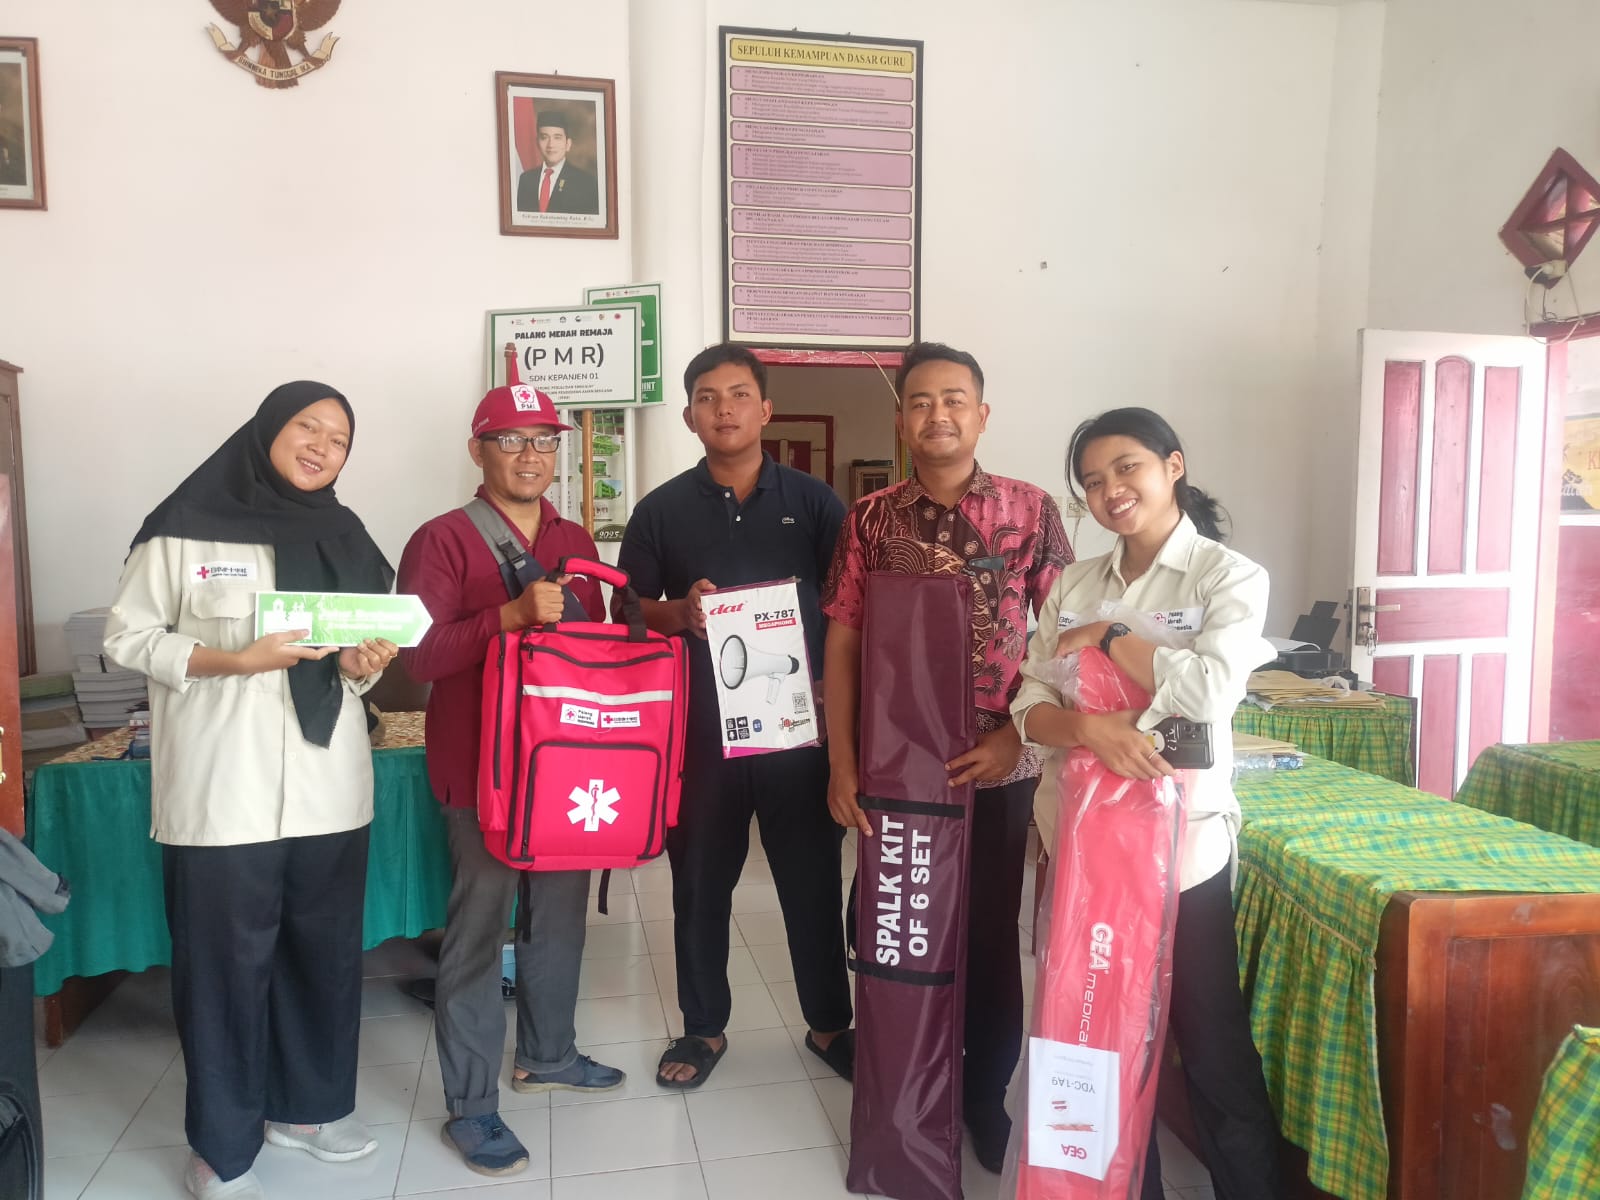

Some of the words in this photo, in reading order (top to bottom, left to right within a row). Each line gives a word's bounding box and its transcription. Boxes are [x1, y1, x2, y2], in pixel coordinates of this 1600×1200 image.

[737, 45, 781, 57] SEPULUH
[783, 48, 845, 61] KEMAMPUAN
[847, 54, 878, 65] DASAR
[880, 57, 906, 67] GURU
[514, 331, 546, 340] PALANG
[549, 330, 577, 338] MERAH
[579, 328, 613, 337] REMAJA
[554, 347, 573, 366] M
[548, 373, 588, 382] KEPANJEN
[589, 372, 599, 380] 01
[754, 609, 795, 622] PX-787
[758, 619, 794, 629] MEGAPHONE
[880, 815, 904, 865] KIT
[910, 829, 931, 885] SET
[909, 893, 930, 910] 6
[875, 872, 902, 966] SPALK
[908, 918, 929, 957] OF
[1089, 921, 1115, 970] GEA
[1051, 1076, 1096, 1095] YDC-1A9
[1061, 1143, 1088, 1160] GEA
